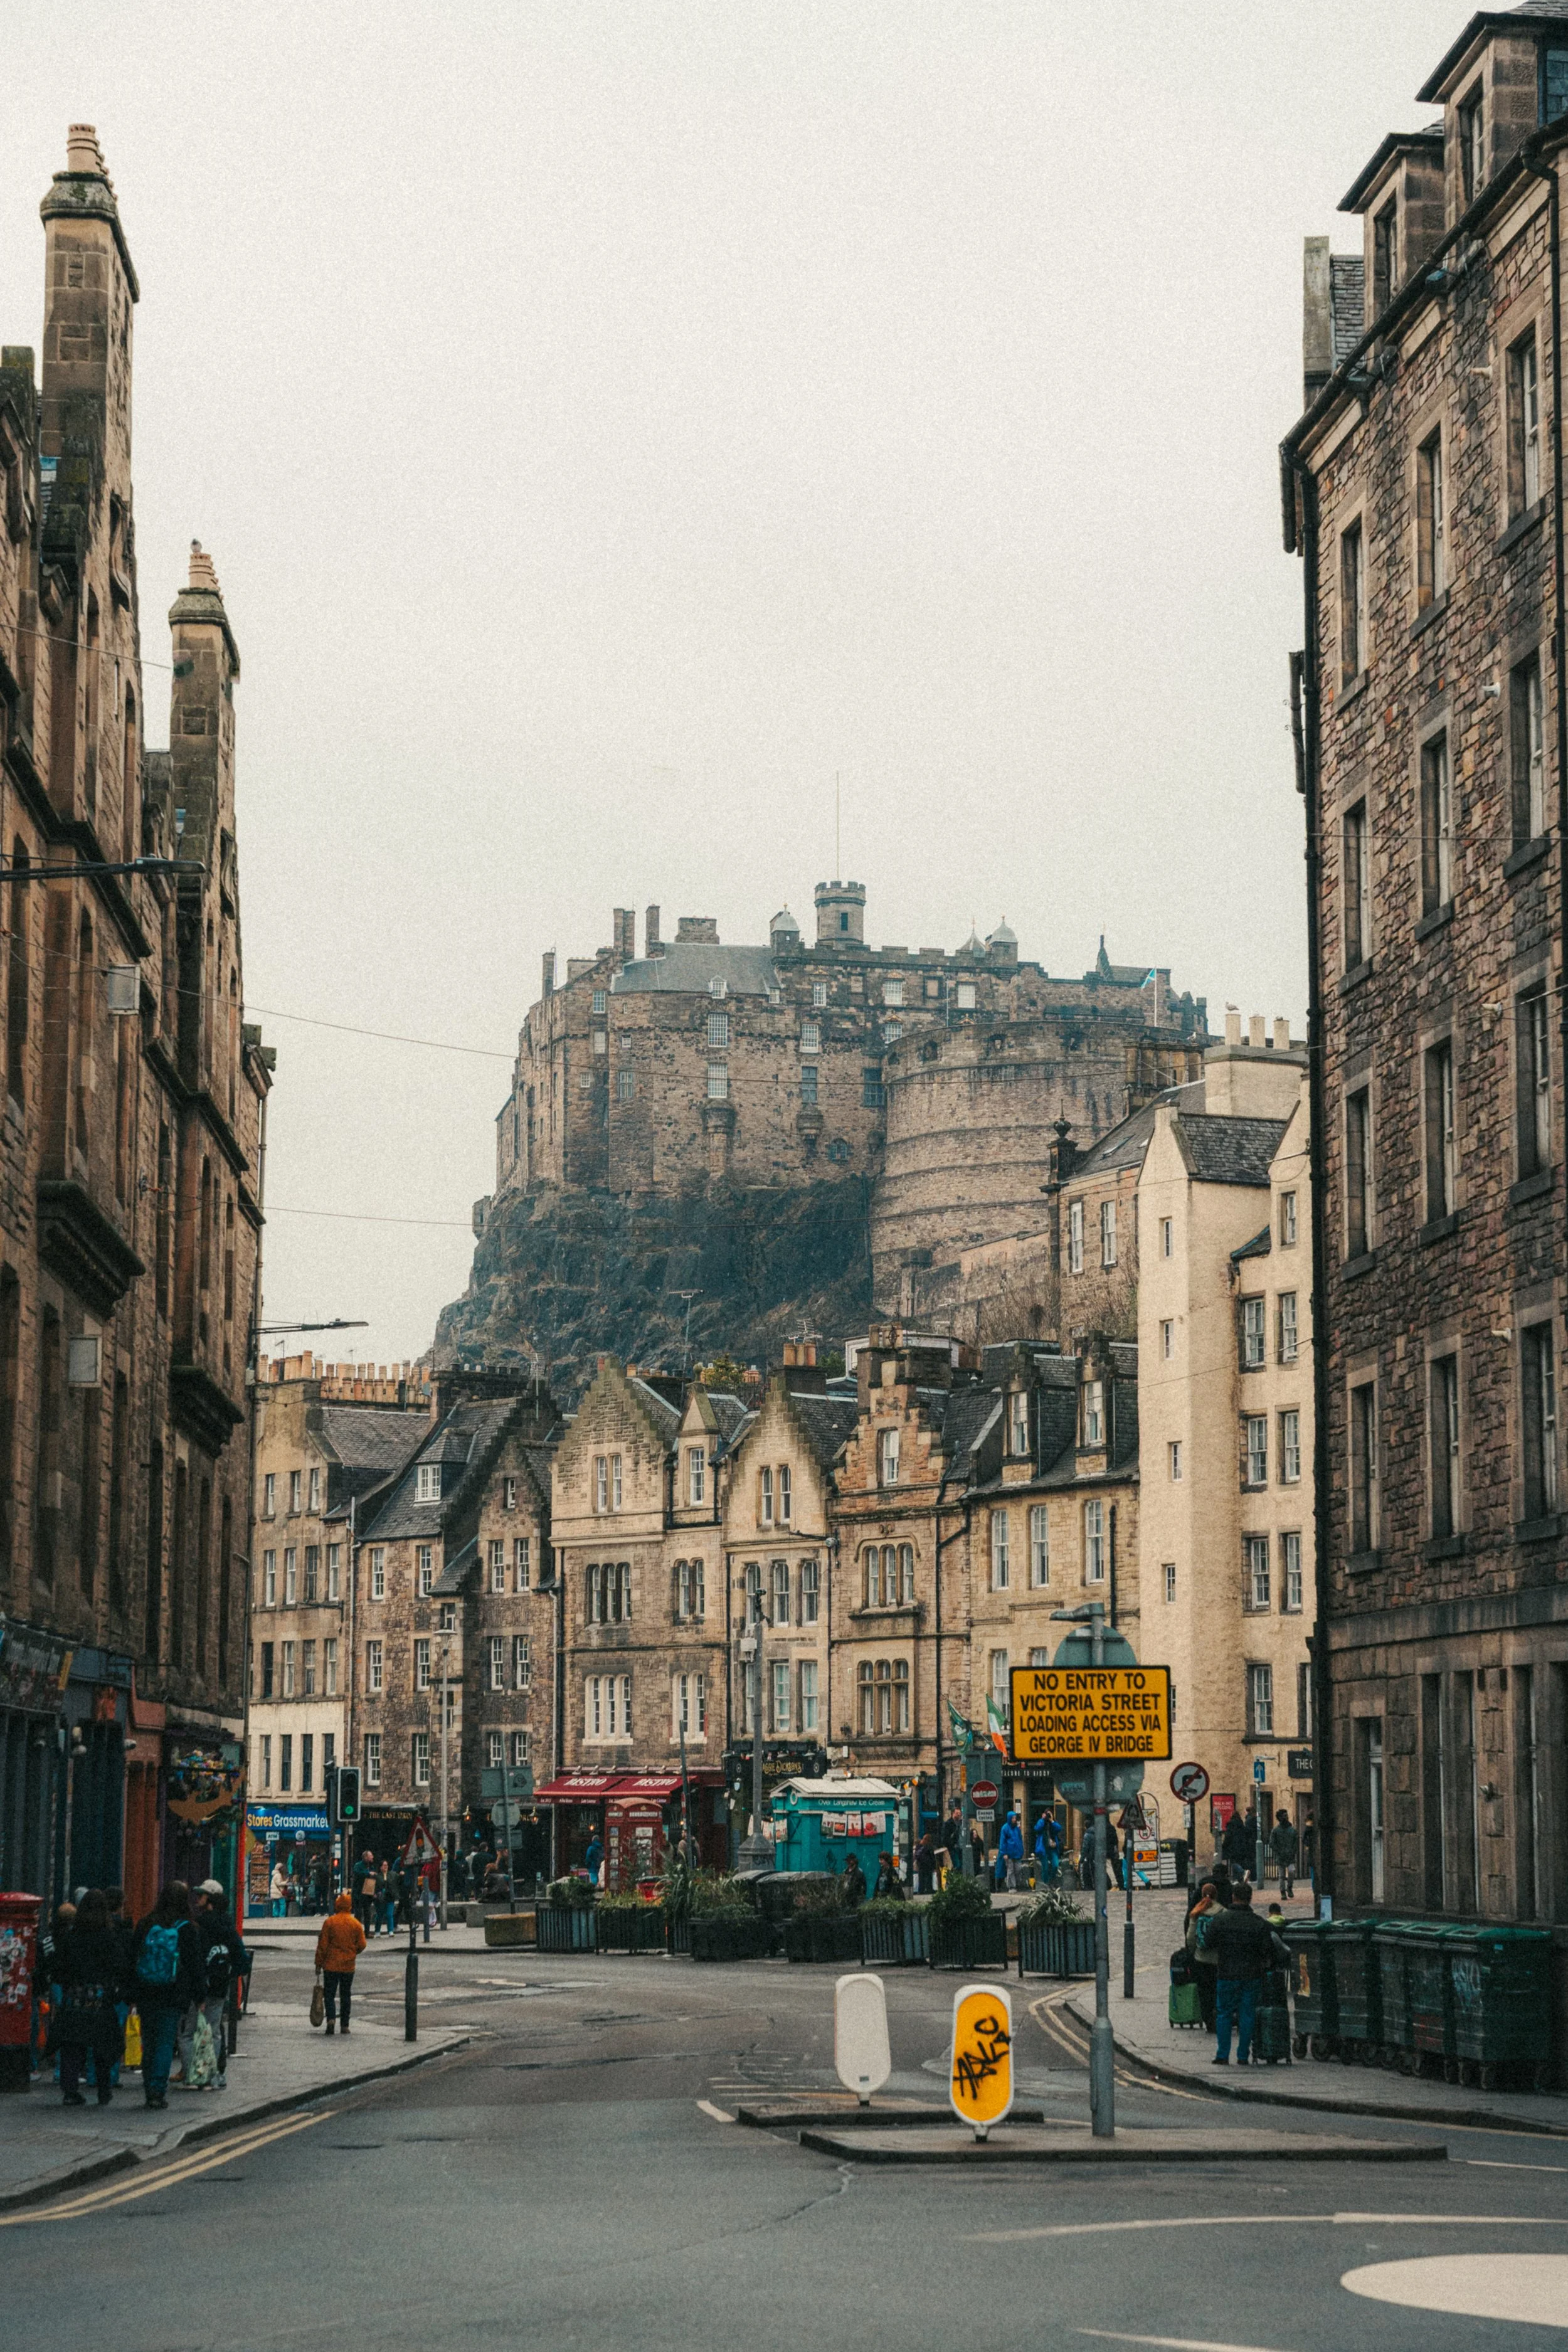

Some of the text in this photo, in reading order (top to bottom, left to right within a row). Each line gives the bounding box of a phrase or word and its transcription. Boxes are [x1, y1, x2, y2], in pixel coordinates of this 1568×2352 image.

[1034, 1673, 1146, 1690] NO ENTRY TO
[1020, 1693, 1161, 1712] VICTORIA STREET
[1020, 1714, 1162, 1733] LOADING ACCESS VIA
[1029, 1735, 1154, 1754] GEORGE IV BRIDGE
[1295, 1759, 1309, 1769] THE
[564, 1778, 607, 1786] BISTRO
[633, 1778, 677, 1787] BISTRO
[247, 1814, 273, 1827] Stores
